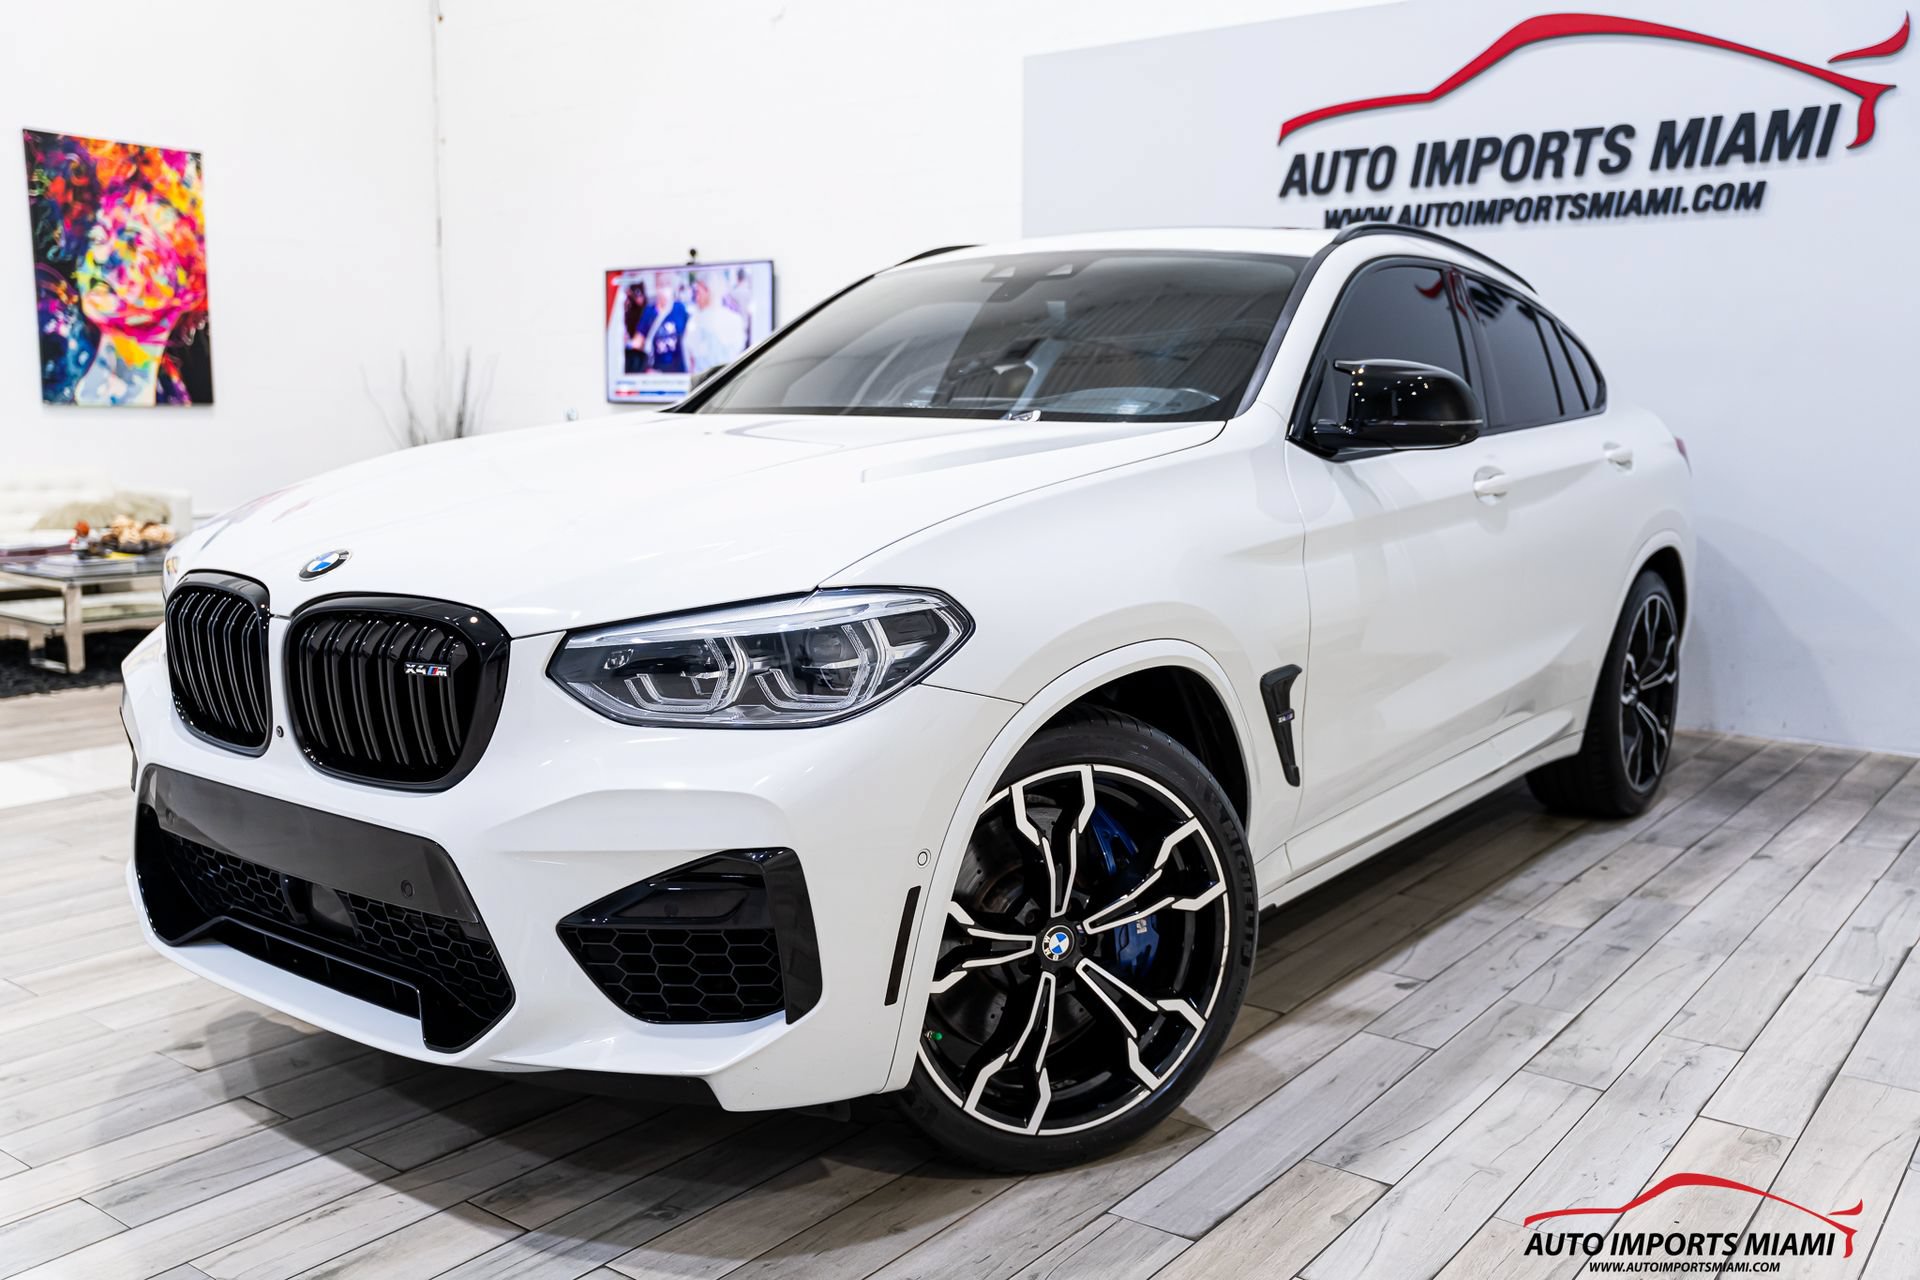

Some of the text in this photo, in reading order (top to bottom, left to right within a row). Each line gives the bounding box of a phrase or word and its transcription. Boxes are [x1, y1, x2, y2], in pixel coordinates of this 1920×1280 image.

[1280, 104, 1842, 198] AUTO IMPORTS MIAMI
[1324, 180, 1767, 229] WWWAUTOIMPORTSMIAMI.COM
